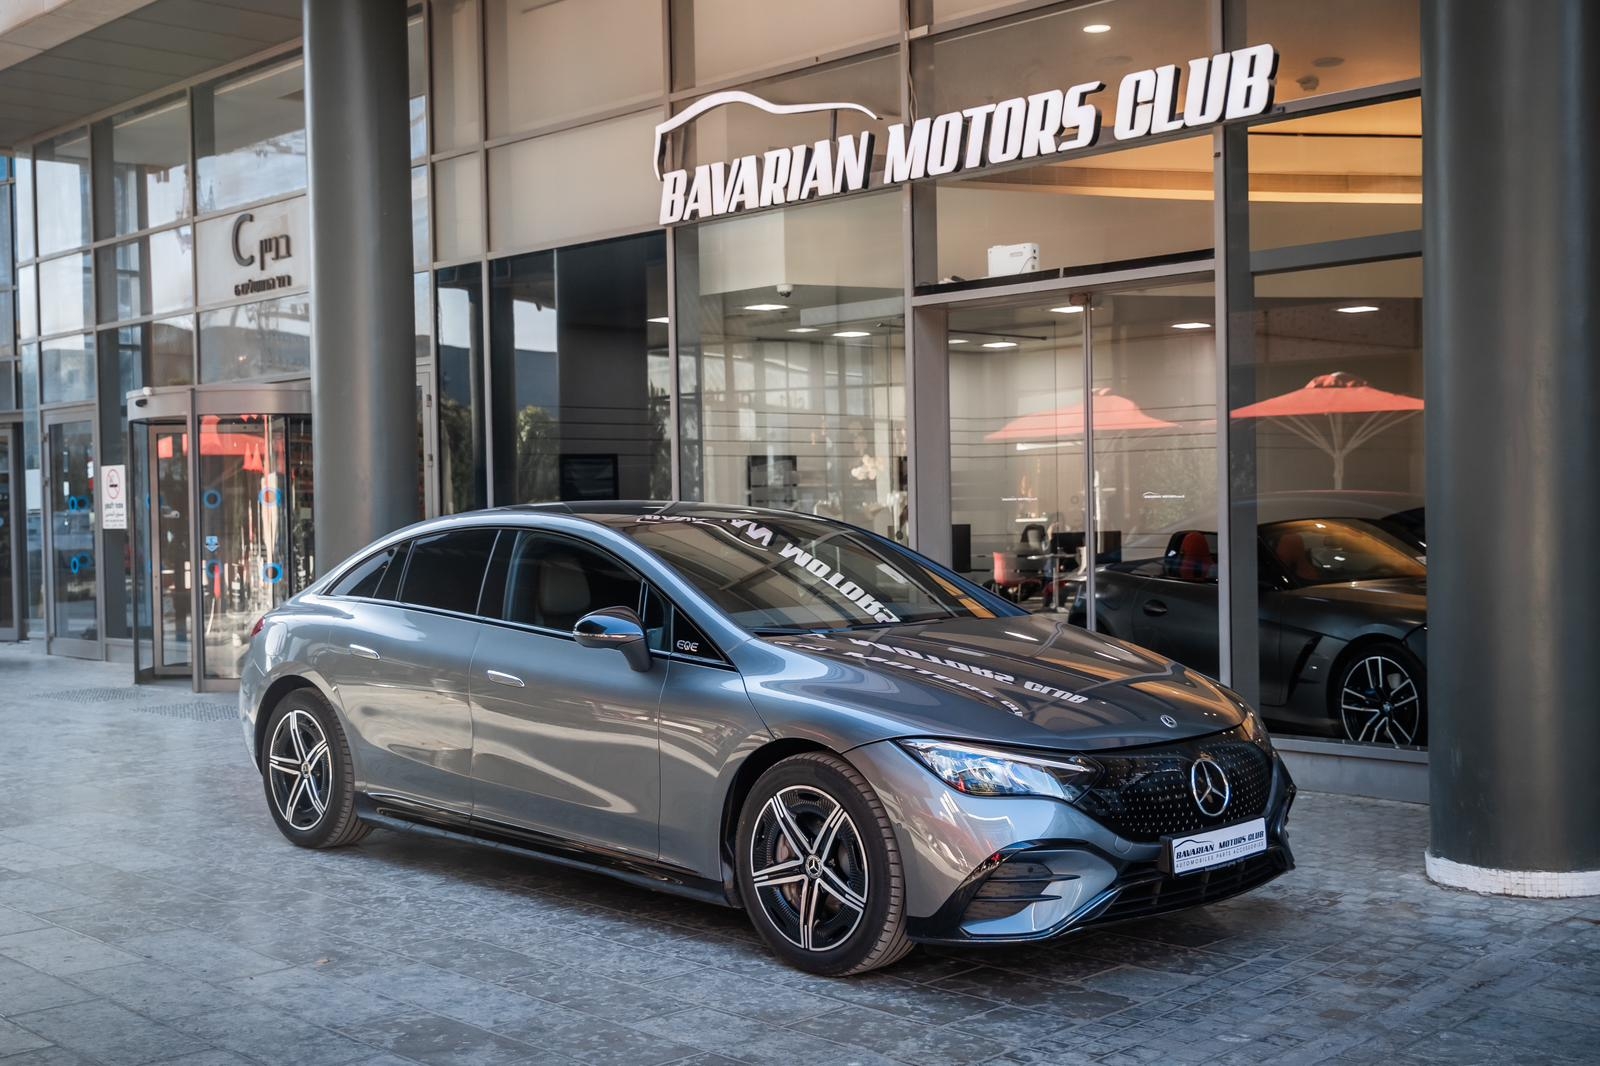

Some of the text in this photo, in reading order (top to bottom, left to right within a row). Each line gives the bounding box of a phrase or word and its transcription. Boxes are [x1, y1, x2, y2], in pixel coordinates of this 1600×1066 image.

[659, 43, 1277, 226] BAVARIAN MOTORS CLUB
[231, 213, 293, 271] בניין C
[234, 284, 241, 297] 6
[676, 639, 699, 652] EQE
[1176, 830, 1264, 859] BAVARIAN MOTORS CLUB
